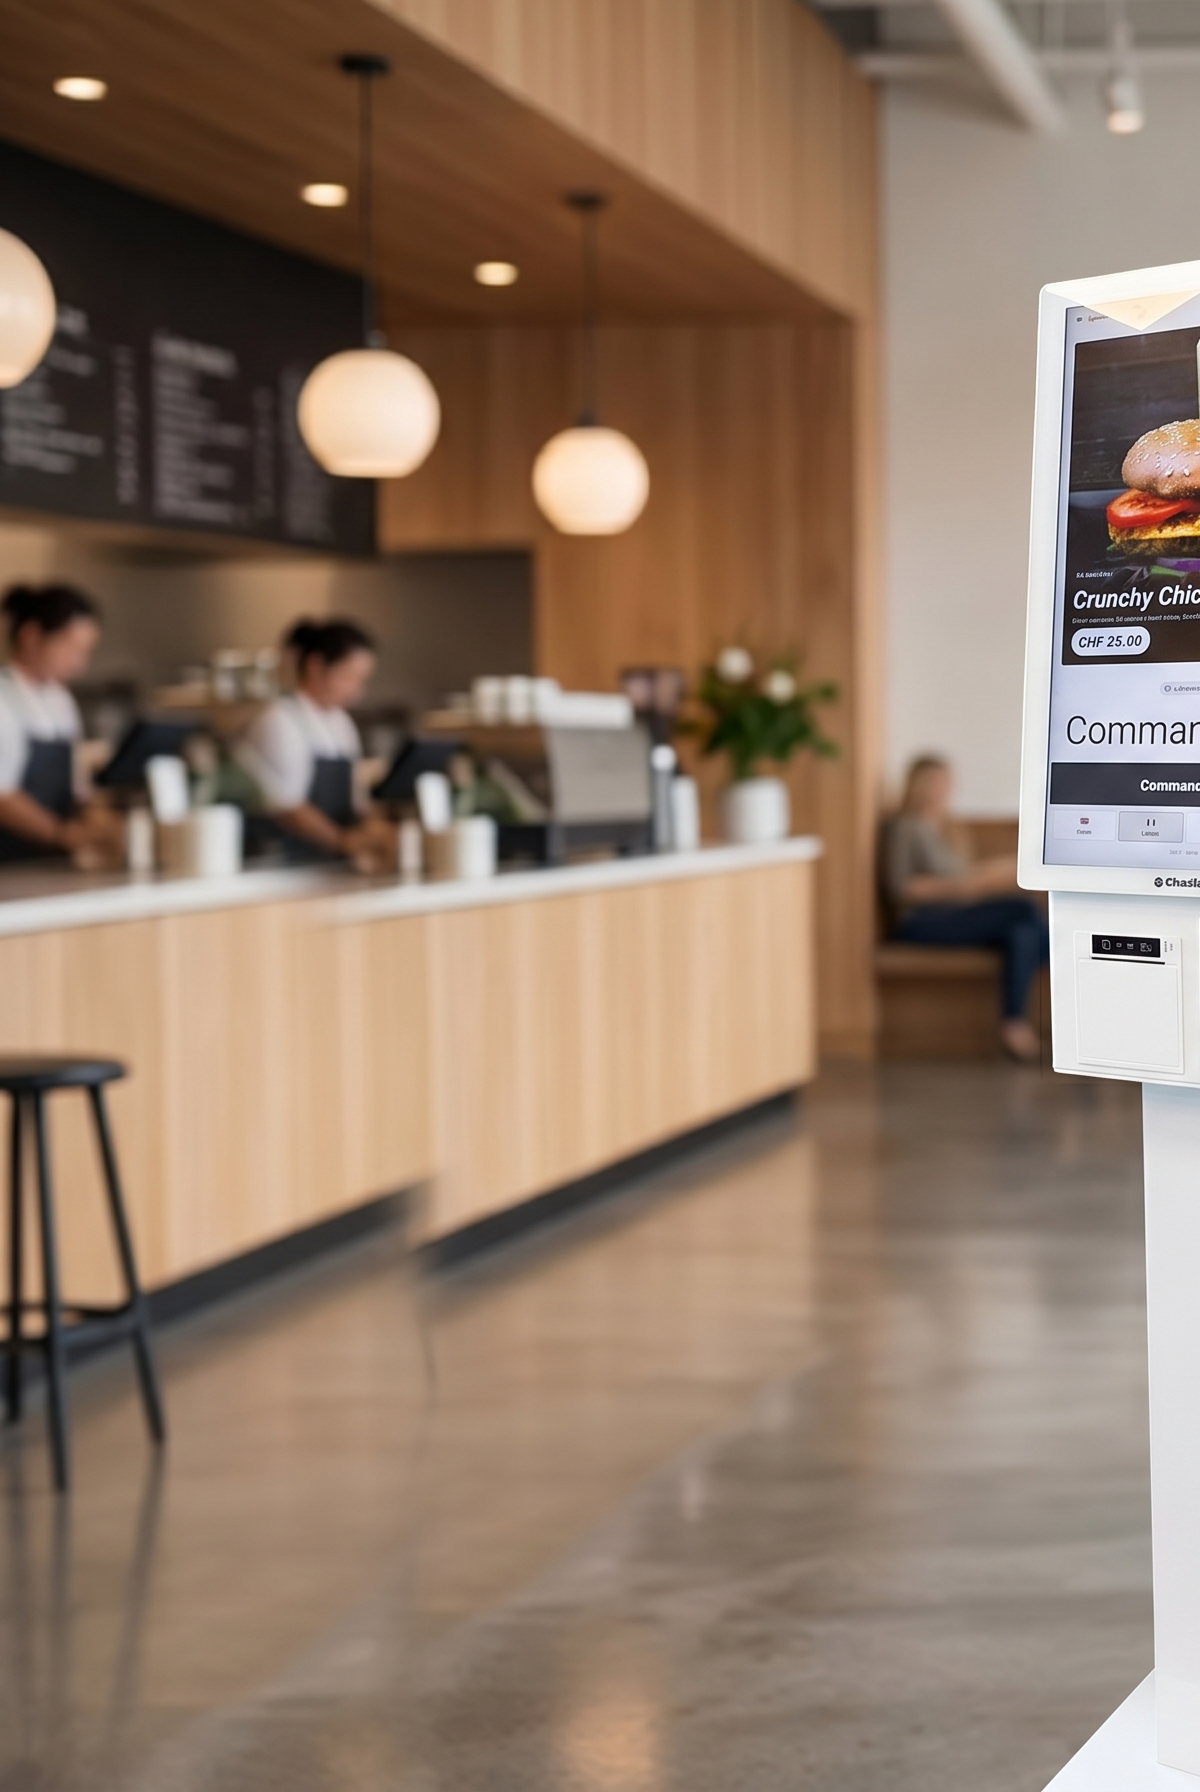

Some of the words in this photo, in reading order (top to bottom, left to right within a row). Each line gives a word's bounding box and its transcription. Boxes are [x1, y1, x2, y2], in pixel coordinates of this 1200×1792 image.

[1073, 587, 1154, 611] Crunchy
[1078, 636, 1104, 648] CHF
[1106, 634, 1142, 648] 25.00
